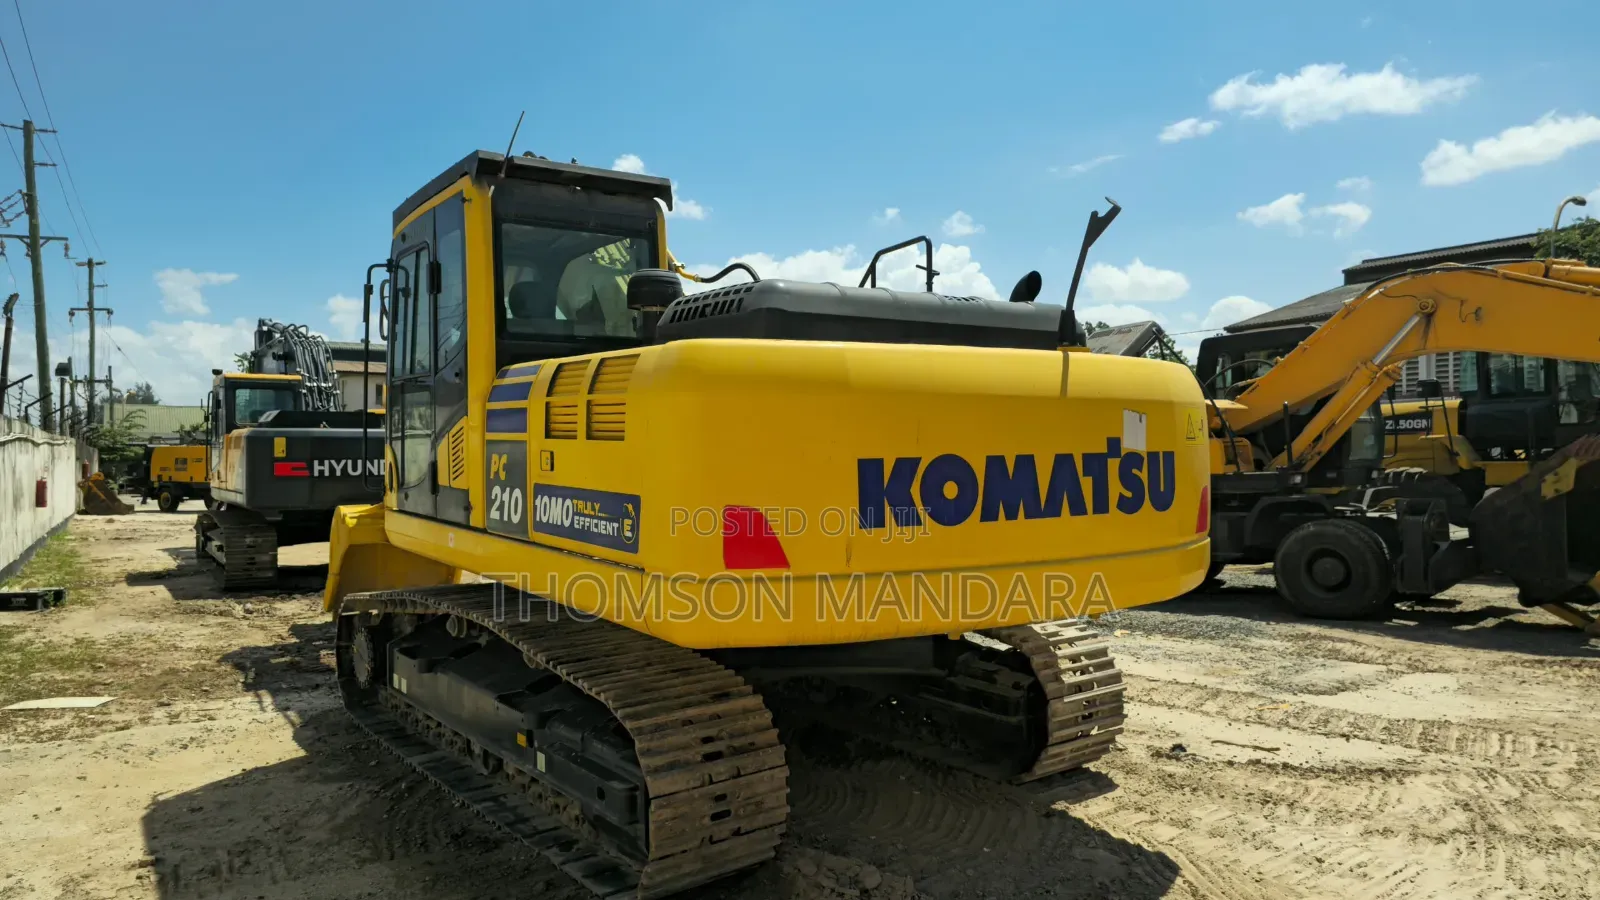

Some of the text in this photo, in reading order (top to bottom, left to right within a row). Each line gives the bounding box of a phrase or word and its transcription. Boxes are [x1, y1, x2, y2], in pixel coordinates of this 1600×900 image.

[490, 453, 507, 480] PC
[857, 436, 1176, 529] KOMATSU
[490, 485, 522, 524] 210
[573, 515, 619, 537] EFFICIENT
